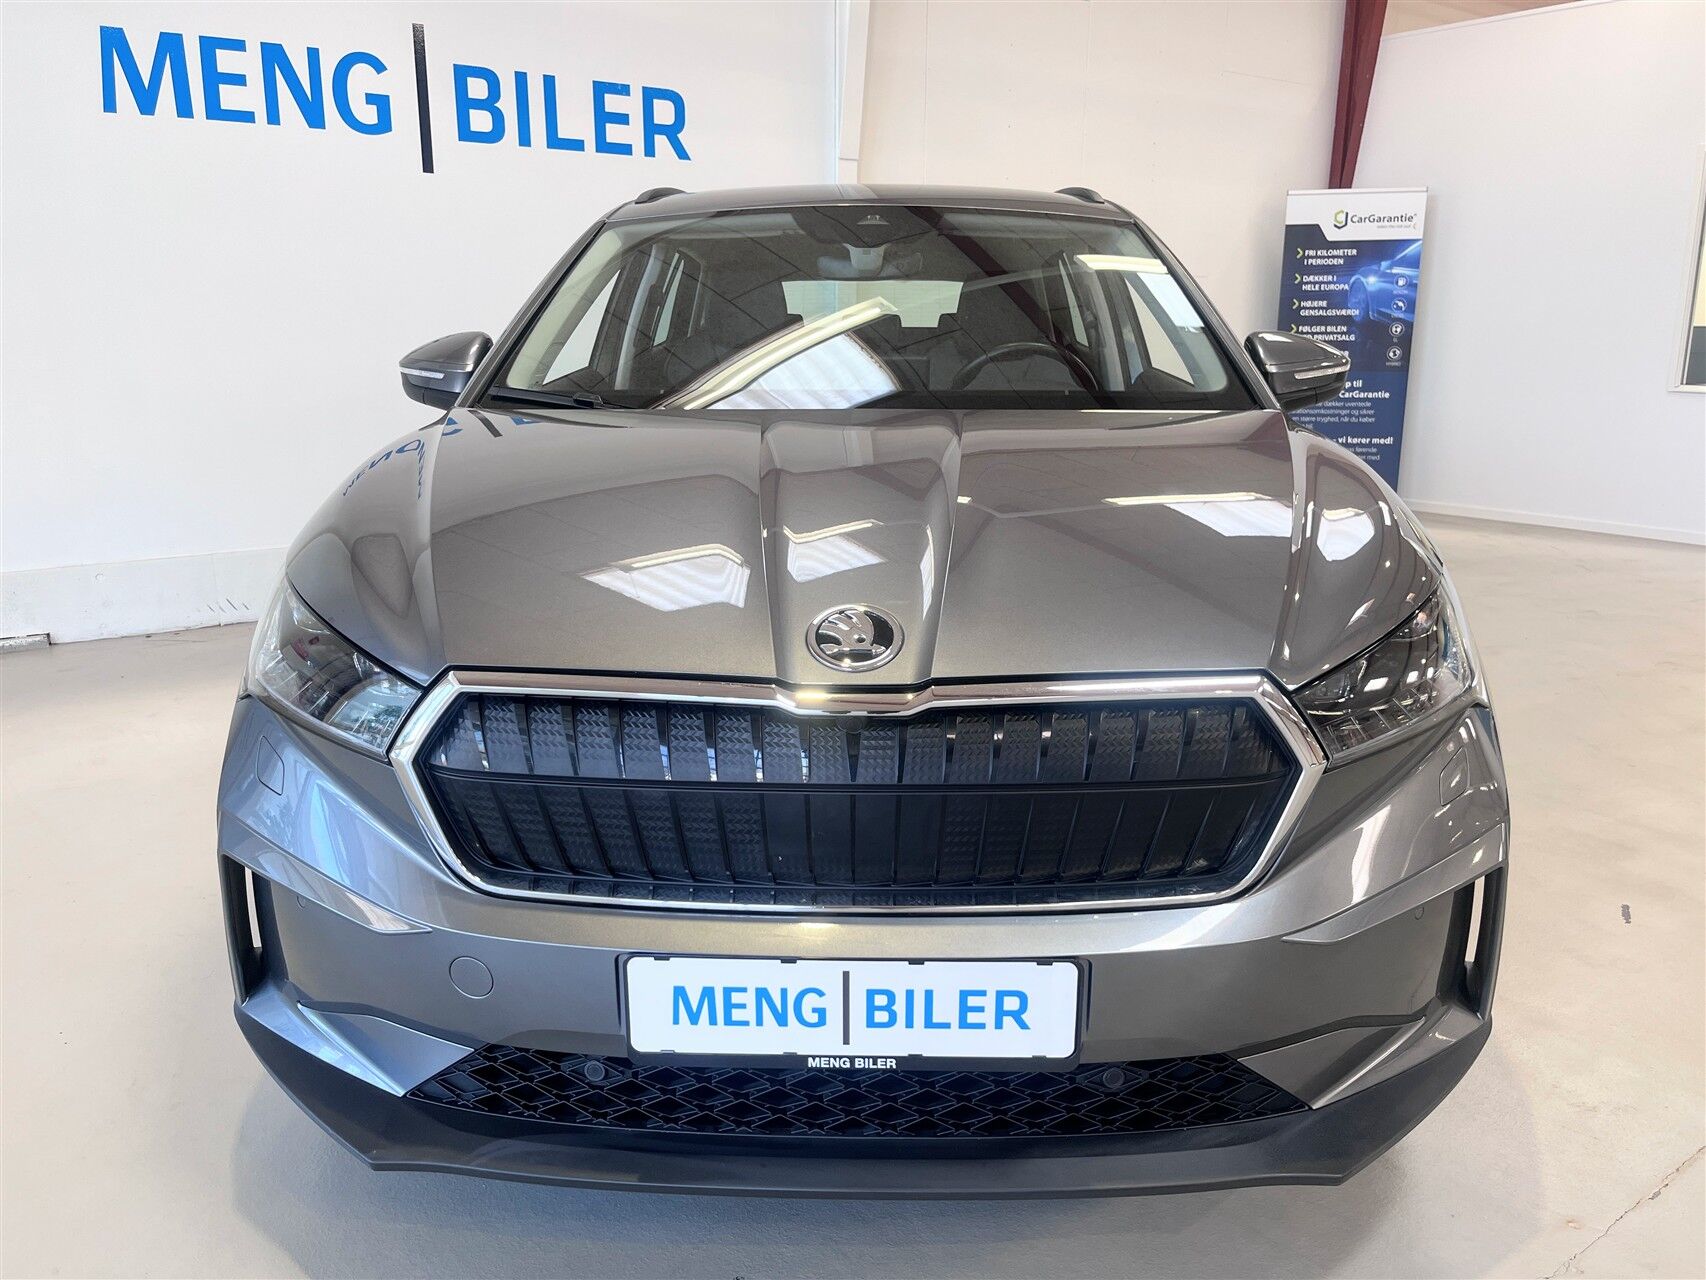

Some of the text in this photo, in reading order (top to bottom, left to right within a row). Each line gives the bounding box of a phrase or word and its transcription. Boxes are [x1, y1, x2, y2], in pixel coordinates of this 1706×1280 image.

[100, 25, 691, 161] MENG BILER
[1350, 213, 1414, 224] CarGarantie
[1304, 248, 1357, 257] FRI KILOMETER
[1321, 283, 1349, 291] EUROPA
[1300, 300, 1328, 308] HØJERE
[1300, 308, 1359, 316] GENSALGSVÆRDI
[1353, 379, 1362, 388] til
[1338, 390, 1390, 399] CarGarantie
[1338, 436, 1346, 444] vi
[1347, 436, 1371, 444] kører
[1372, 436, 1394, 445] med!
[671, 985, 1031, 1030] MENG BILER
[808, 1056, 897, 1070] MENG BILER
